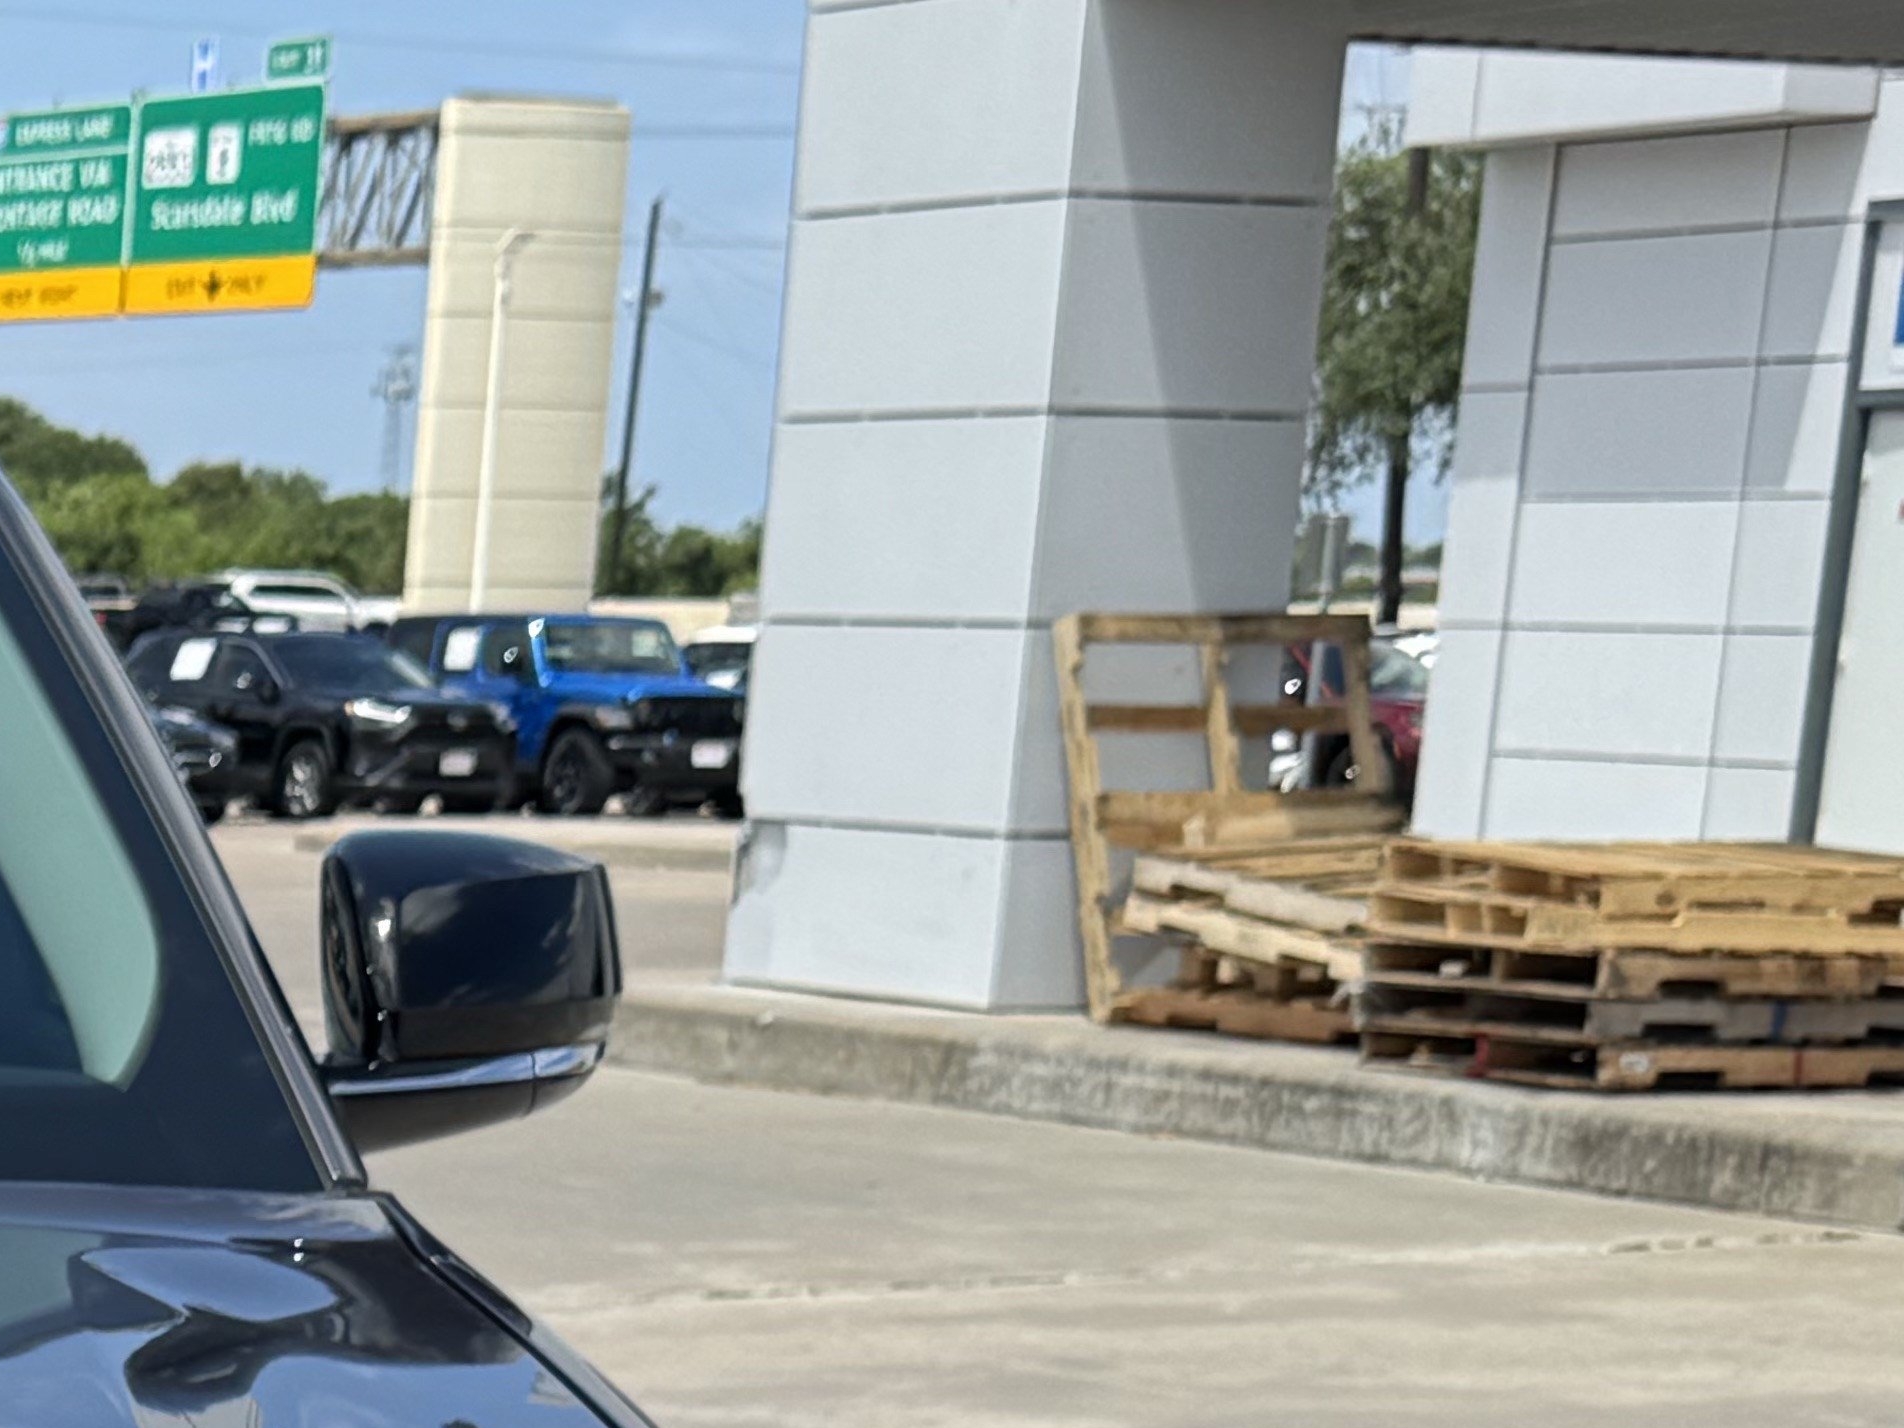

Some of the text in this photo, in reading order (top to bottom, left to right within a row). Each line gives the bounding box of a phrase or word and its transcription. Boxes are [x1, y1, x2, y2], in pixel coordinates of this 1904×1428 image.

[66, 193, 120, 228] ROAD
[151, 189, 299, 230] Scarsdale Blvd
